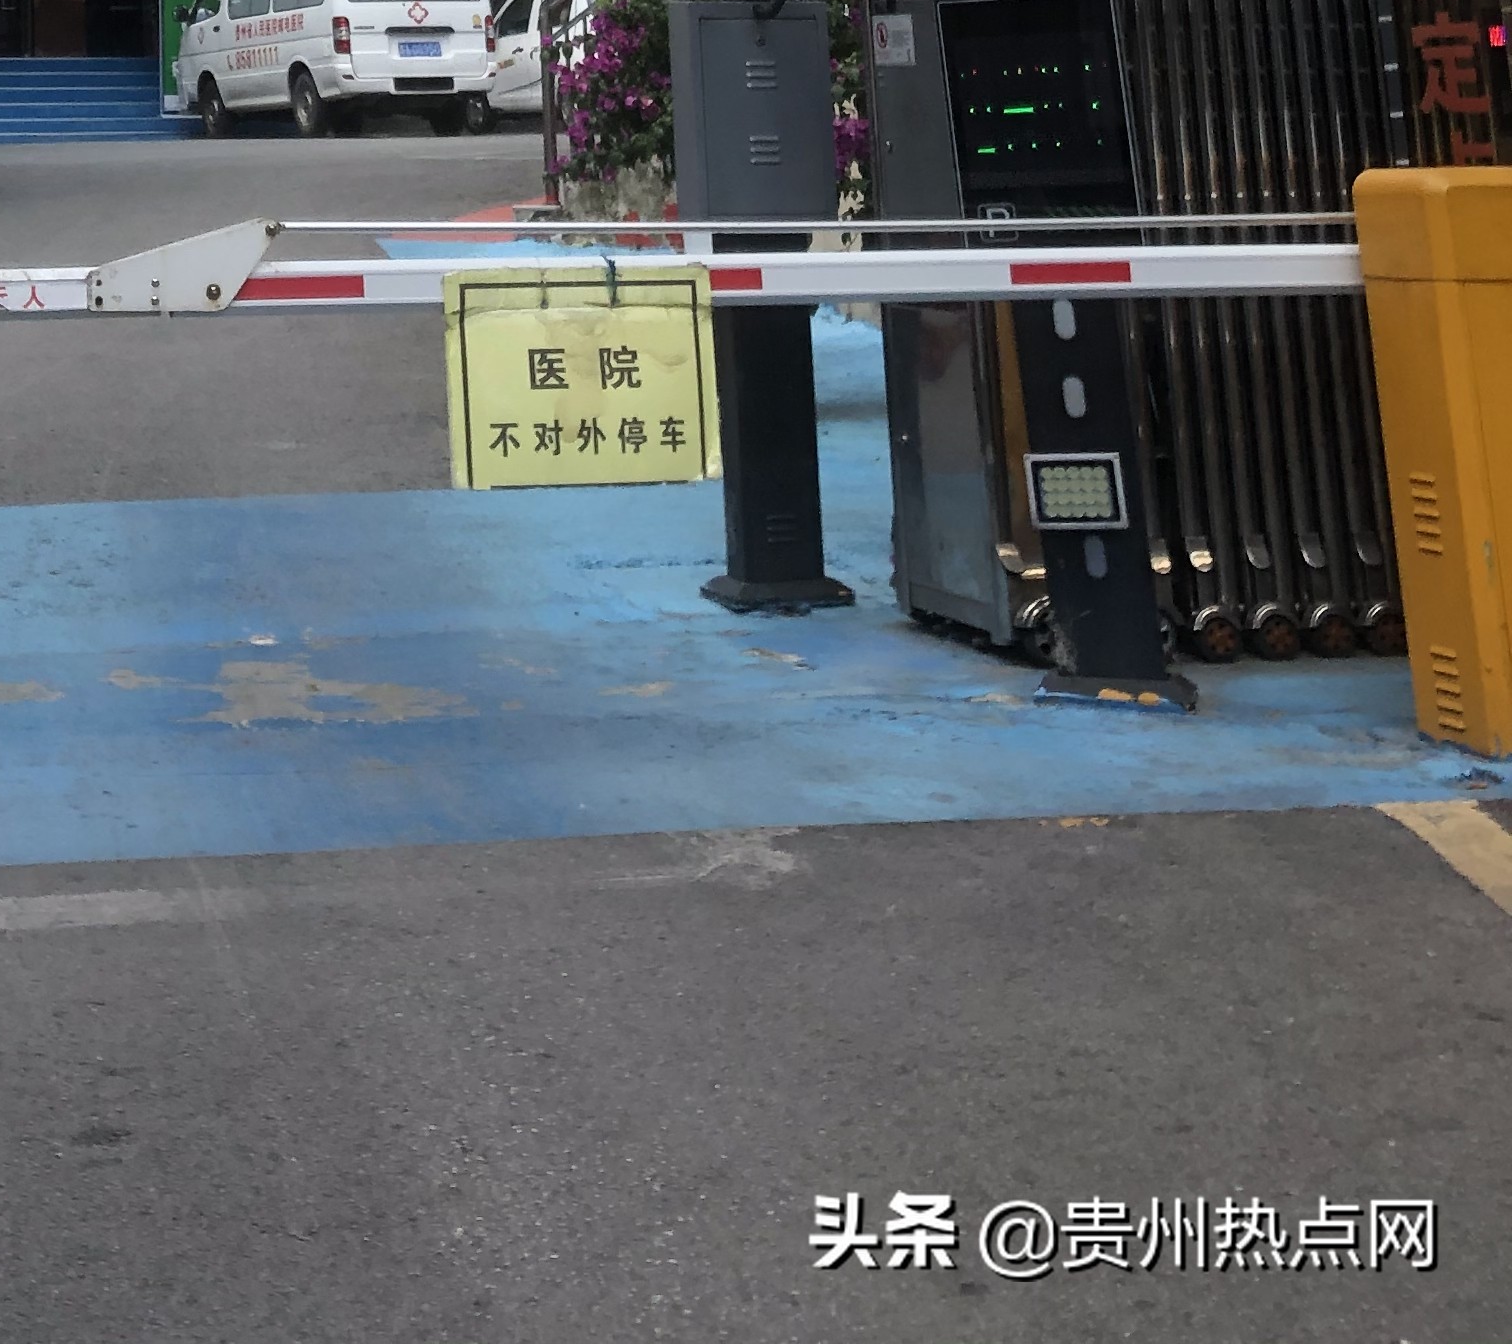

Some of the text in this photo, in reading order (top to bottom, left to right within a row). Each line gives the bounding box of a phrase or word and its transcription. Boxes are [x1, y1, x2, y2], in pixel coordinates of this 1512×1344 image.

[528, 346, 643, 393] 医院
[489, 417, 689, 455] 不对外停车
